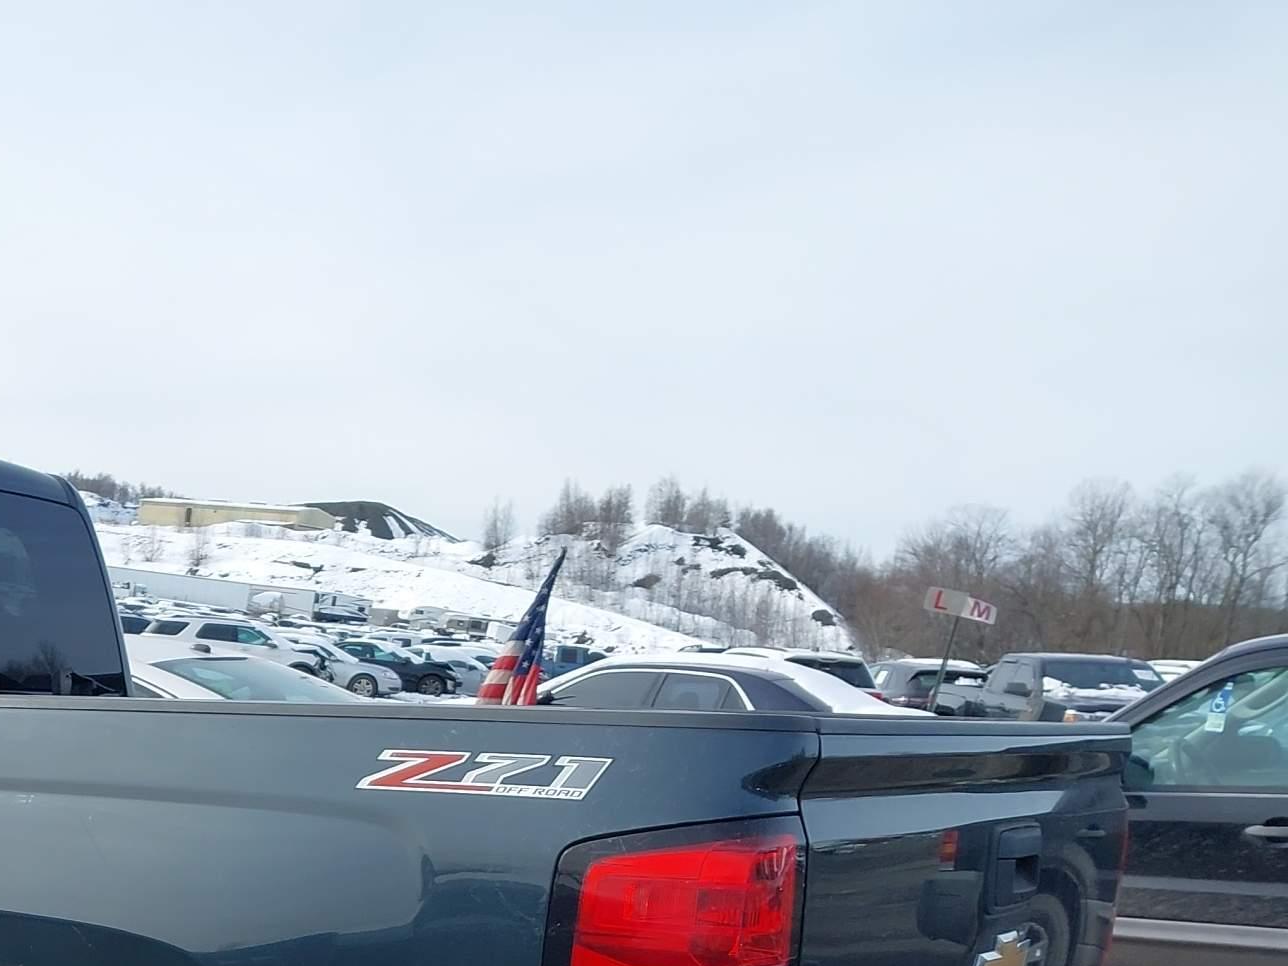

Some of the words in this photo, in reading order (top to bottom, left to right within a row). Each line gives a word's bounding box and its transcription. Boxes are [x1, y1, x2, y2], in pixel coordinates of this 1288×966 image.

[934, 590, 948, 610] L
[970, 600, 991, 621] M
[355, 749, 613, 796] Z71
[495, 785, 530, 795] OFF
[531, 788, 584, 798] ROAD
